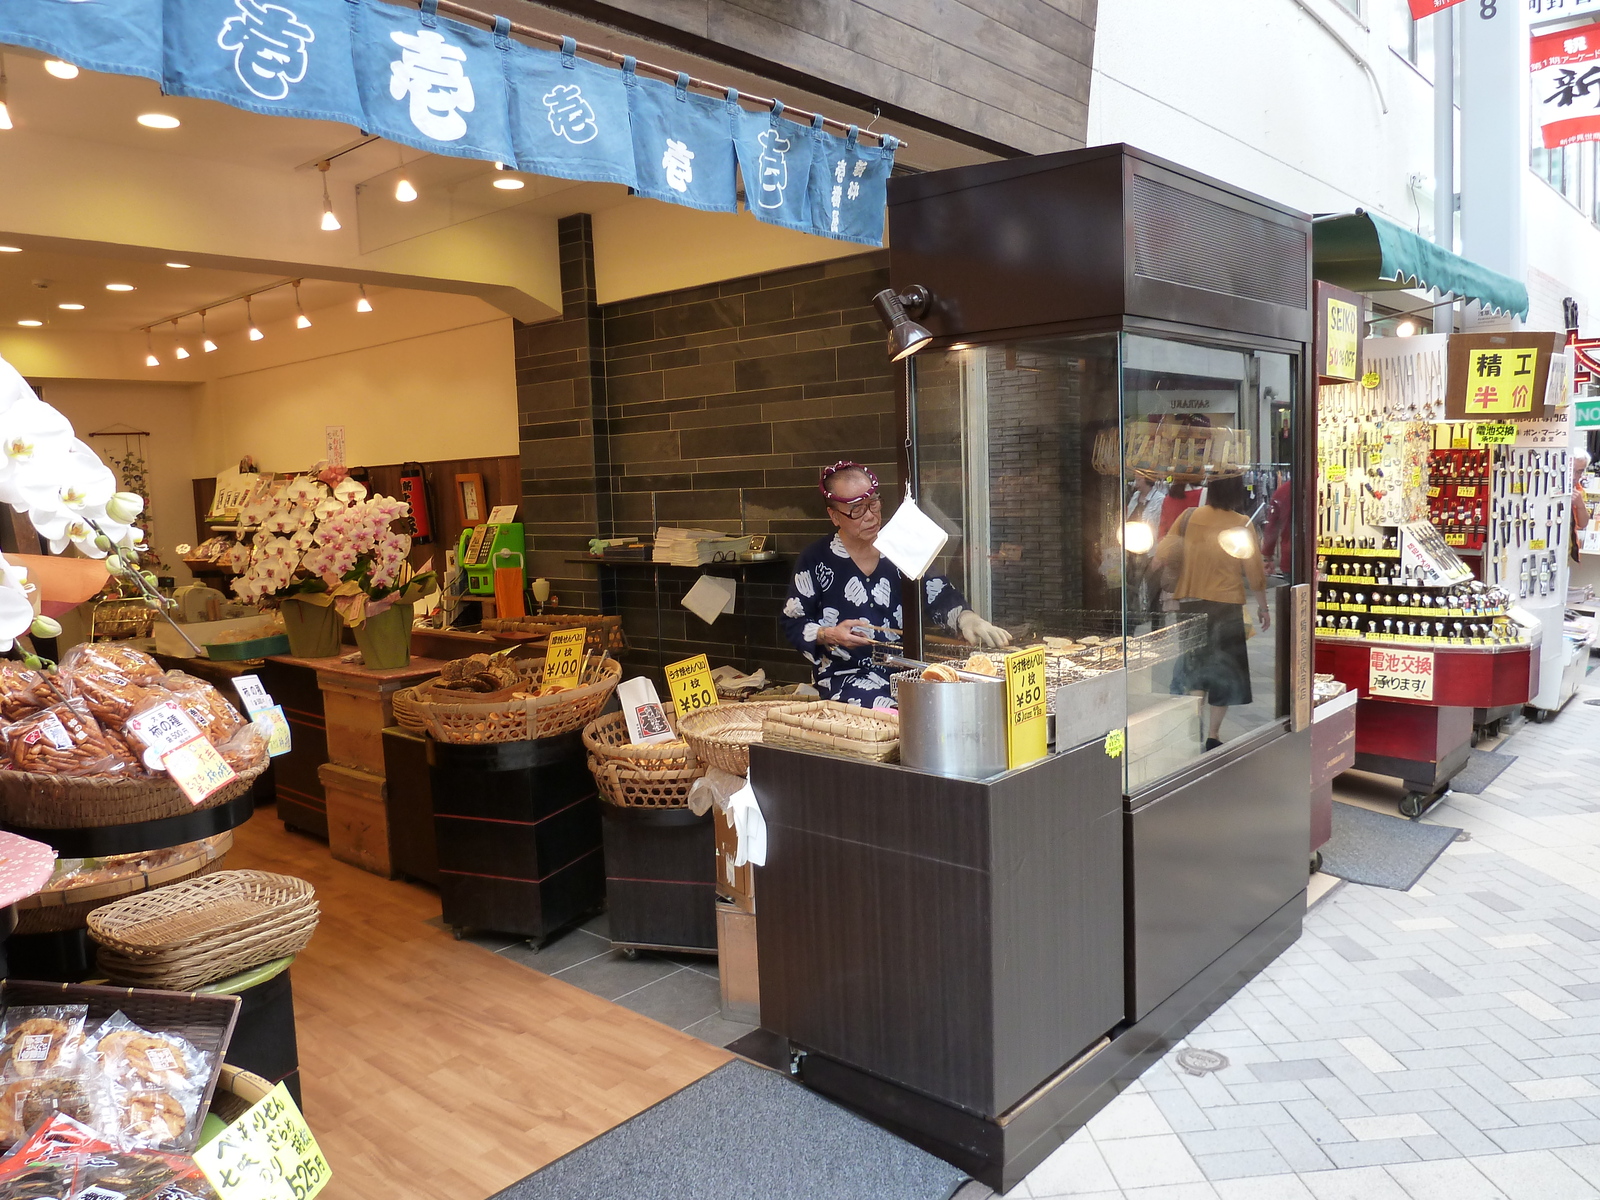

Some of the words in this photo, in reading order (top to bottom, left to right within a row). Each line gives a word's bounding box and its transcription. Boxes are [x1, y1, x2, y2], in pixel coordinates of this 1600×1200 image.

[1330, 306, 1356, 335] SEIKO
[1476, 353, 1532, 377] 精工
[1473, 384, 1529, 409] 半价
[1476, 425, 1515, 436] 電池交換
[547, 660, 577, 677] ¥100
[670, 661, 706, 679] うす焼せんべい
[1013, 653, 1043, 674] うす焼せんべい
[1371, 651, 1432, 675] 電池交換
[1373, 674, 1427, 693] 承ります!
[679, 689, 711, 713] ¥50
[1016, 686, 1041, 708] ¥50
[147, 714, 183, 738] 柿の種
